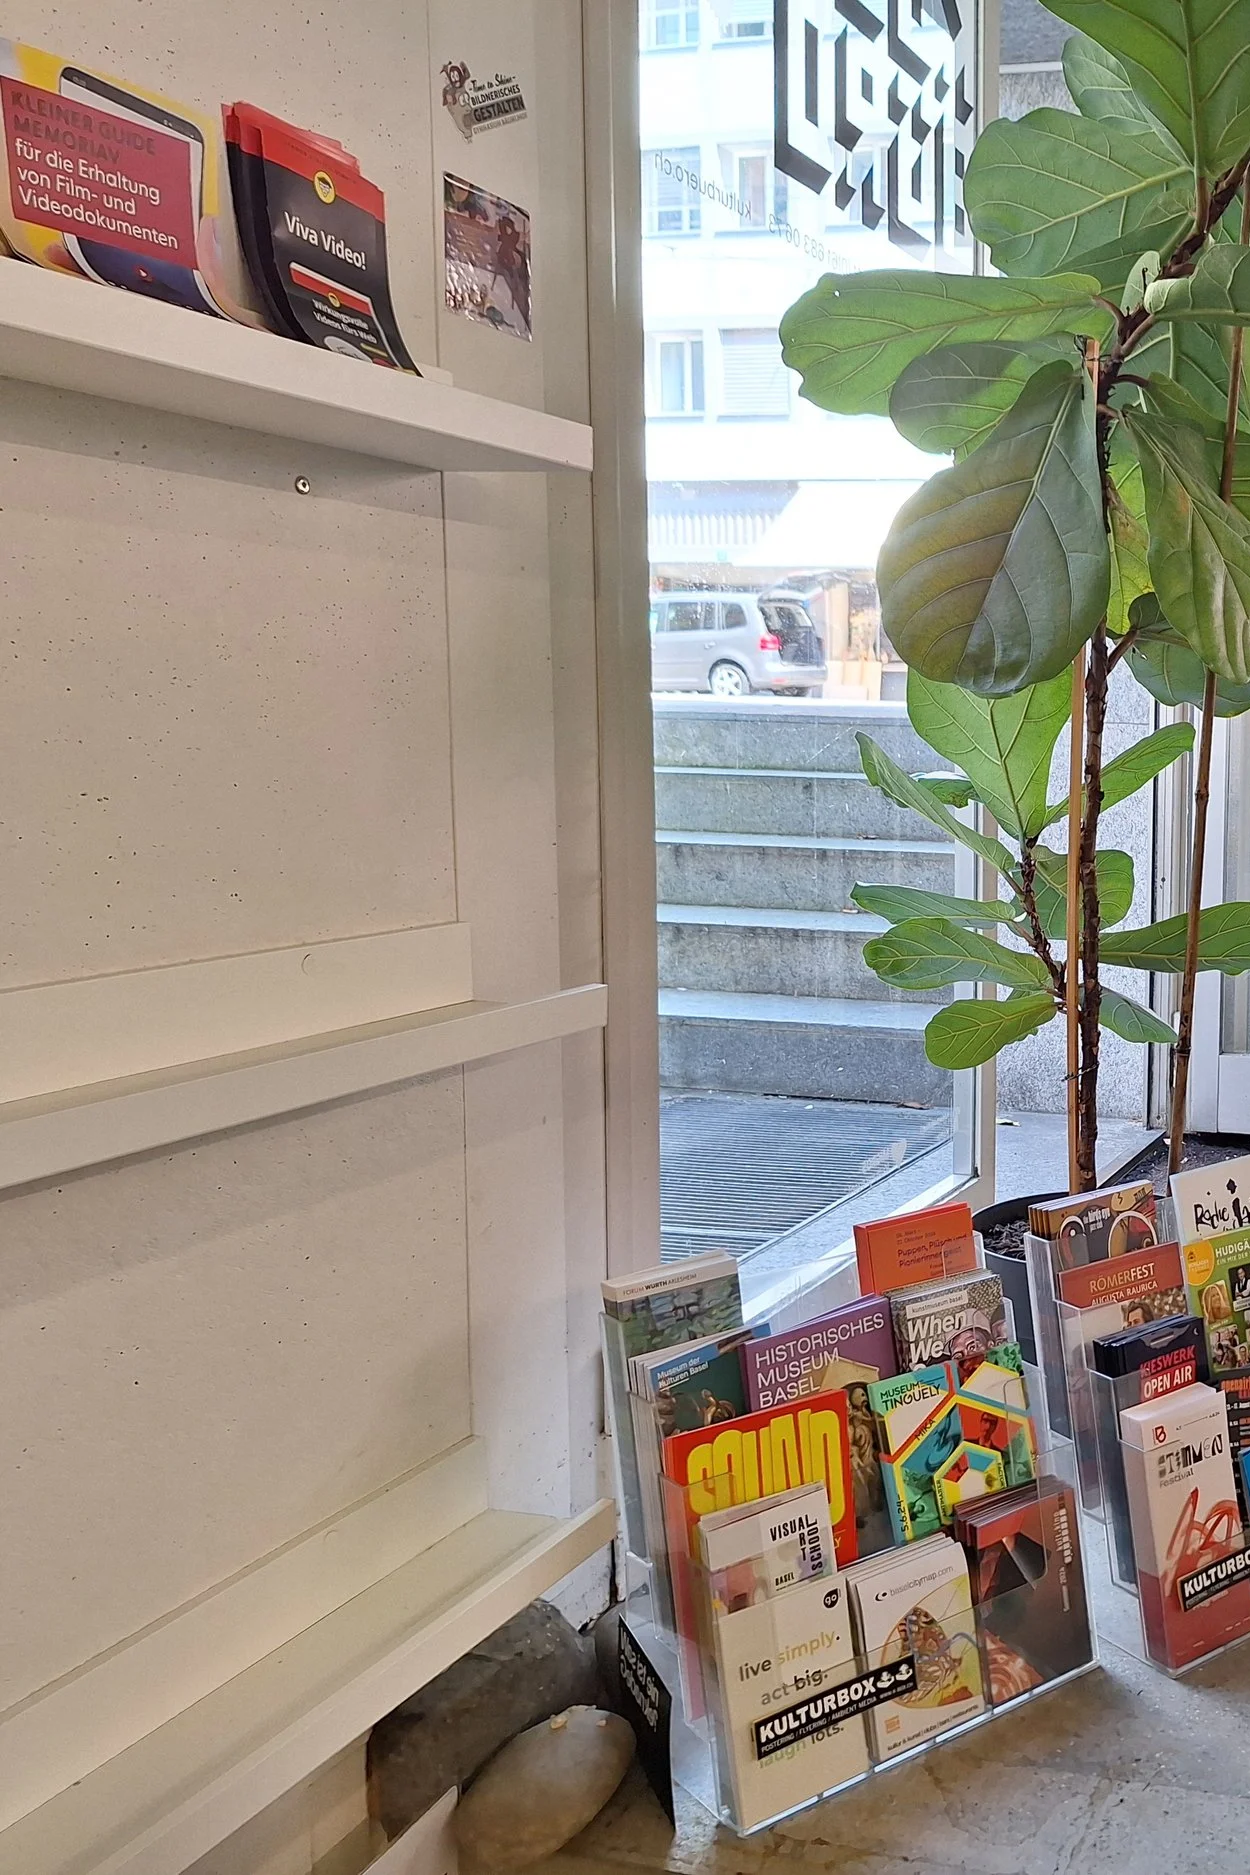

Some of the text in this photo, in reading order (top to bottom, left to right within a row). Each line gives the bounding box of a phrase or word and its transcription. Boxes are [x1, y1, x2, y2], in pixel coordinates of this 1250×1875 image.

[470, 84, 521, 107] BILDNERISCHES
[473, 96, 526, 122] GESTALTEN
[10, 90, 156, 156] KLEINER GUIDE
[15, 137, 160, 205] für die Erhaltung
[17, 166, 136, 215] von Film- und
[18, 185, 179, 249] Videodokumenten
[284, 211, 367, 271] Viva Video!
[1089, 1262, 1155, 1294] RÖMERFEST
[1091, 1280, 1158, 1307] AUGUSTA RAURICA
[754, 1312, 885, 1369] HISTORISCHES
[908, 1311, 967, 1342] When
[910, 1338, 944, 1364] We
[1139, 1344, 1196, 1378] KIESWERK
[657, 1356, 700, 1379] Museum der
[658, 1361, 709, 1388] Kulturen Basel
[756, 1347, 840, 1389] MUSEUM
[1143, 1365, 1193, 1399] OPEN AIR
[759, 1376, 822, 1409] BASEL
[880, 1381, 920, 1399] MUSEUM
[882, 1383, 941, 1412] TINGUELY
[915, 1418, 936, 1442] MIKA
[1159, 1467, 1195, 1489] Festival
[769, 1514, 817, 1542] VISUAL
[775, 1571, 795, 1587] BASEL
[738, 1629, 841, 1682] live simply.
[760, 1668, 829, 1706] act big.
[760, 1675, 877, 1744] KULTURBOX
